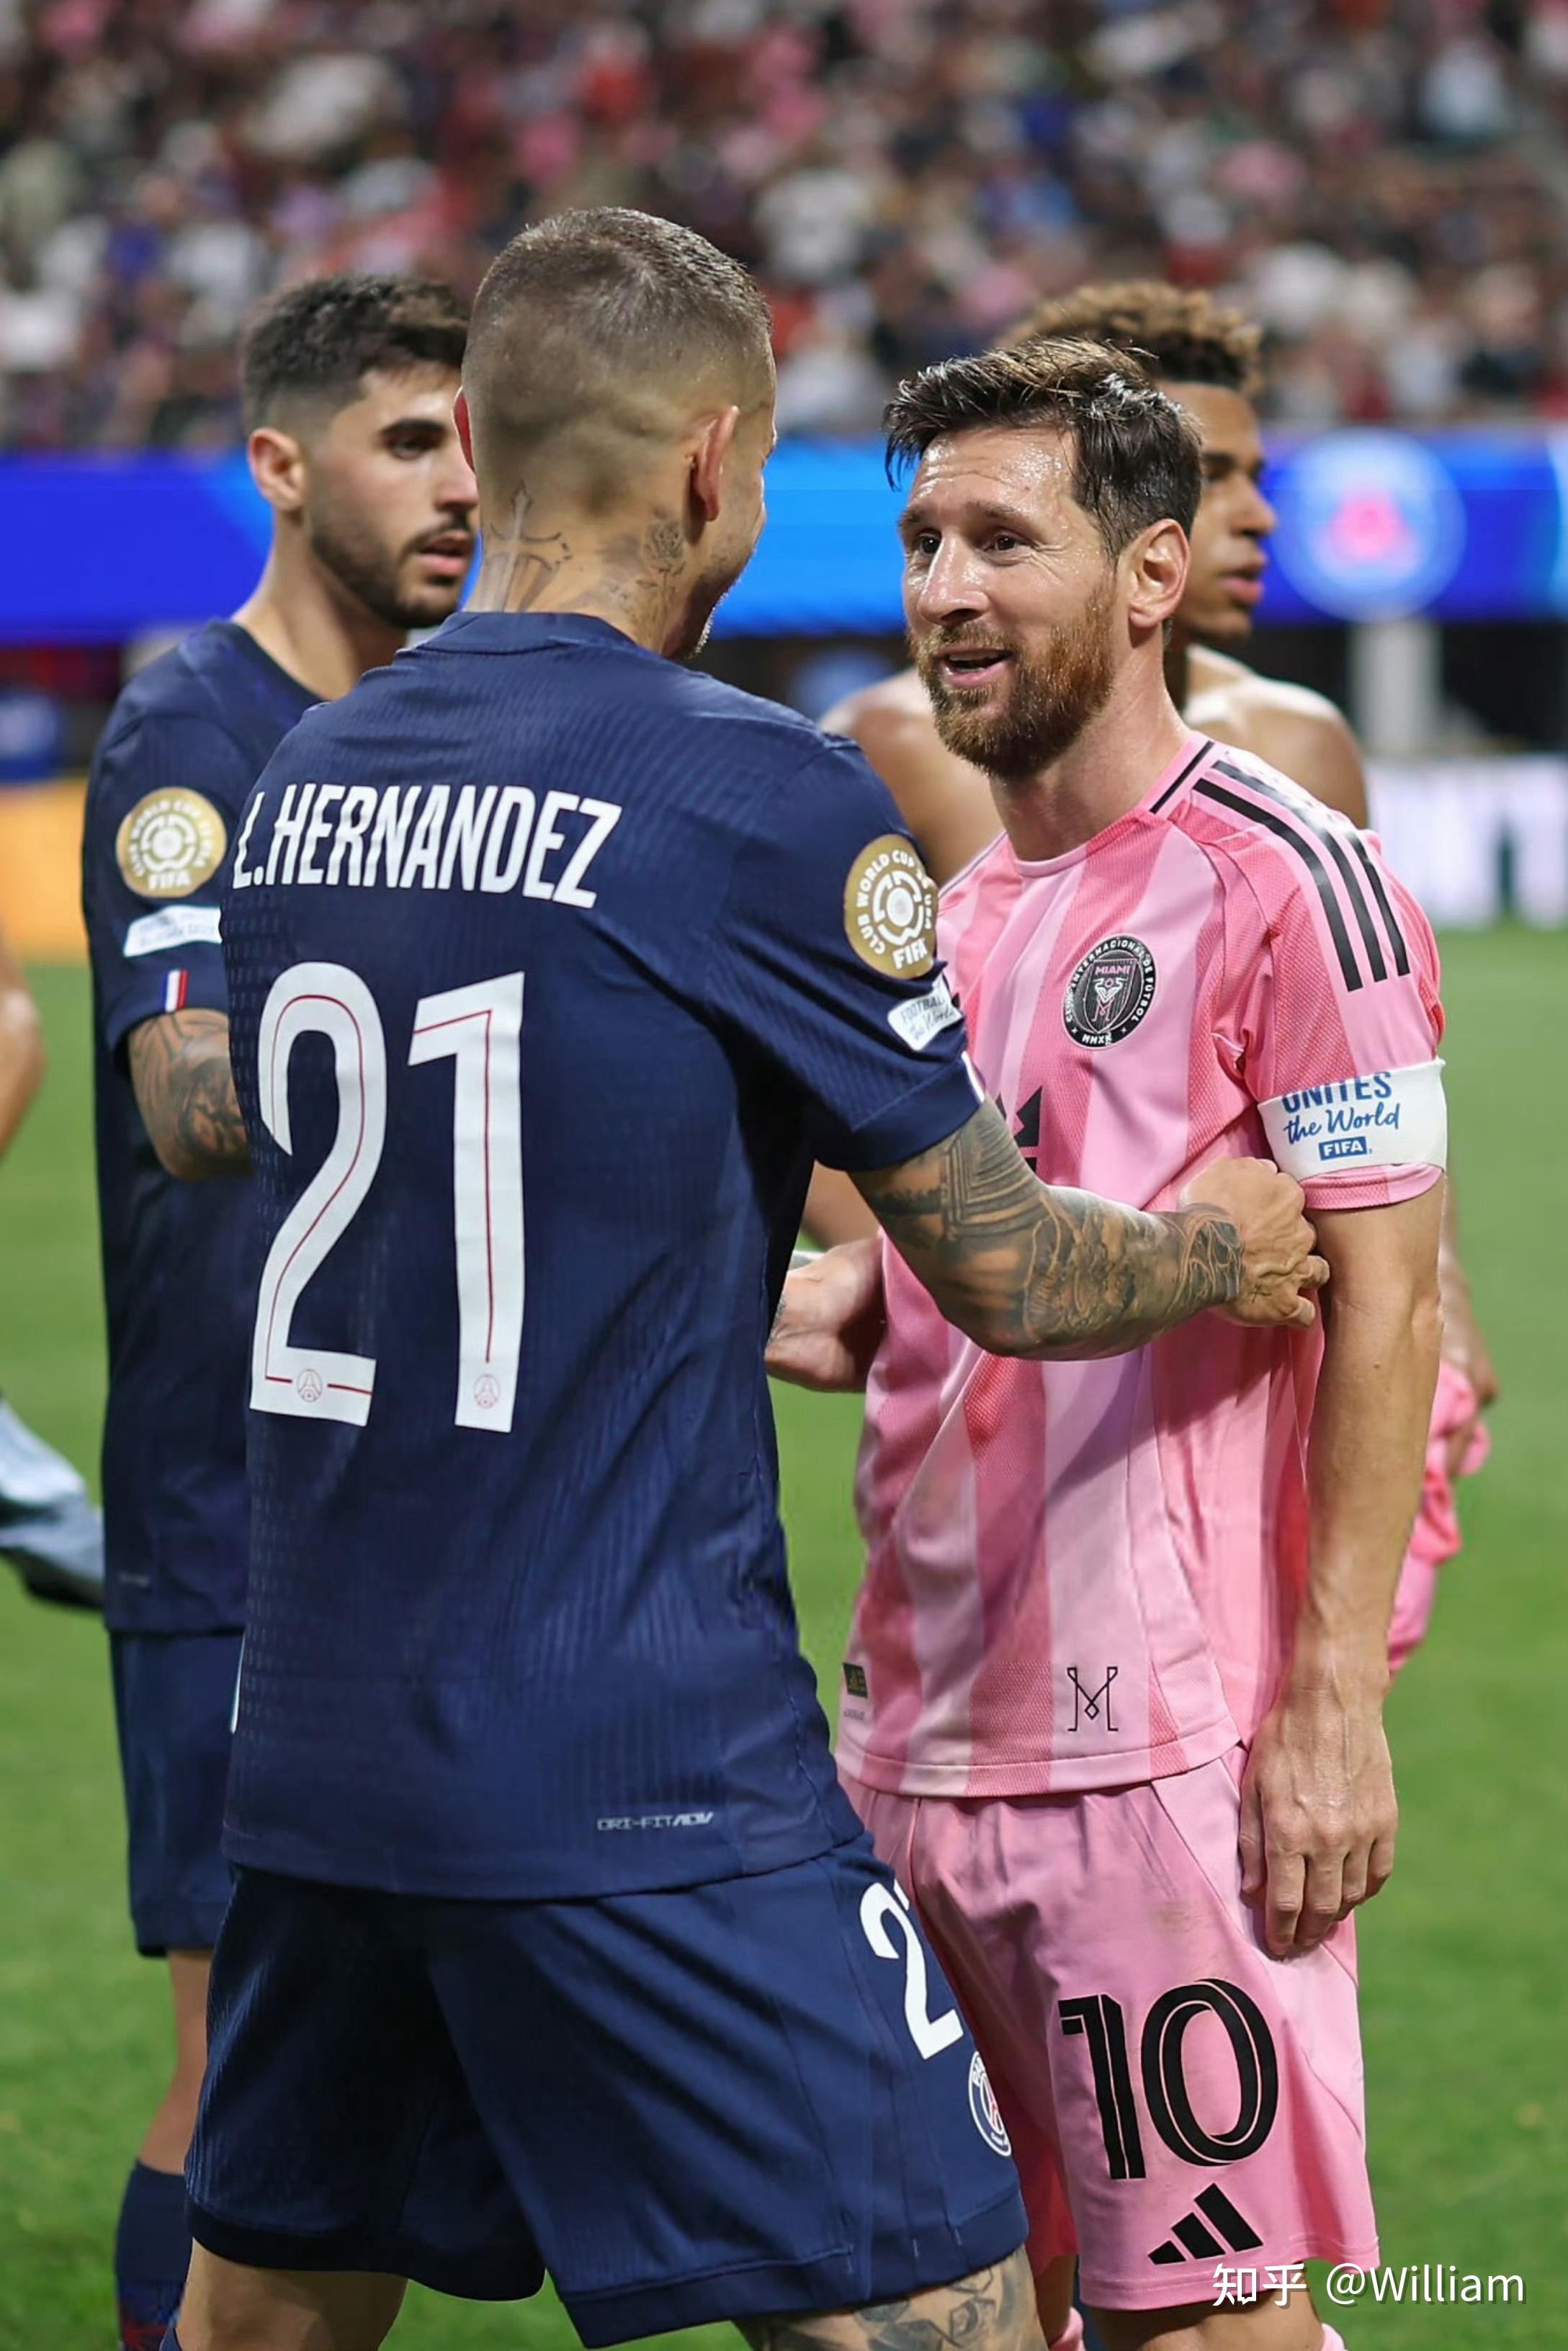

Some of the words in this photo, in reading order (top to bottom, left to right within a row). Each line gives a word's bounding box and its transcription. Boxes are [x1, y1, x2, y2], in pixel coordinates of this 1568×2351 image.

[233, 783, 622, 909] L.HERNANDEZ
[892, 849, 915, 868] CUP
[856, 853, 891, 908] WORLD
[857, 913, 886, 955] CLUB
[892, 937, 928, 970] FIFA
[1095, 965, 1131, 975] MIAMI
[1281, 1071, 1392, 1114] UNITES
[1283, 1115, 1322, 1145] the
[1325, 1101, 1401, 1134] World
[1322, 1139, 1365, 1157] FIFA
[249, 961, 525, 1433] 21
[859, 1878, 964, 2060] 2
[1058, 1977, 1279, 2180] 10
